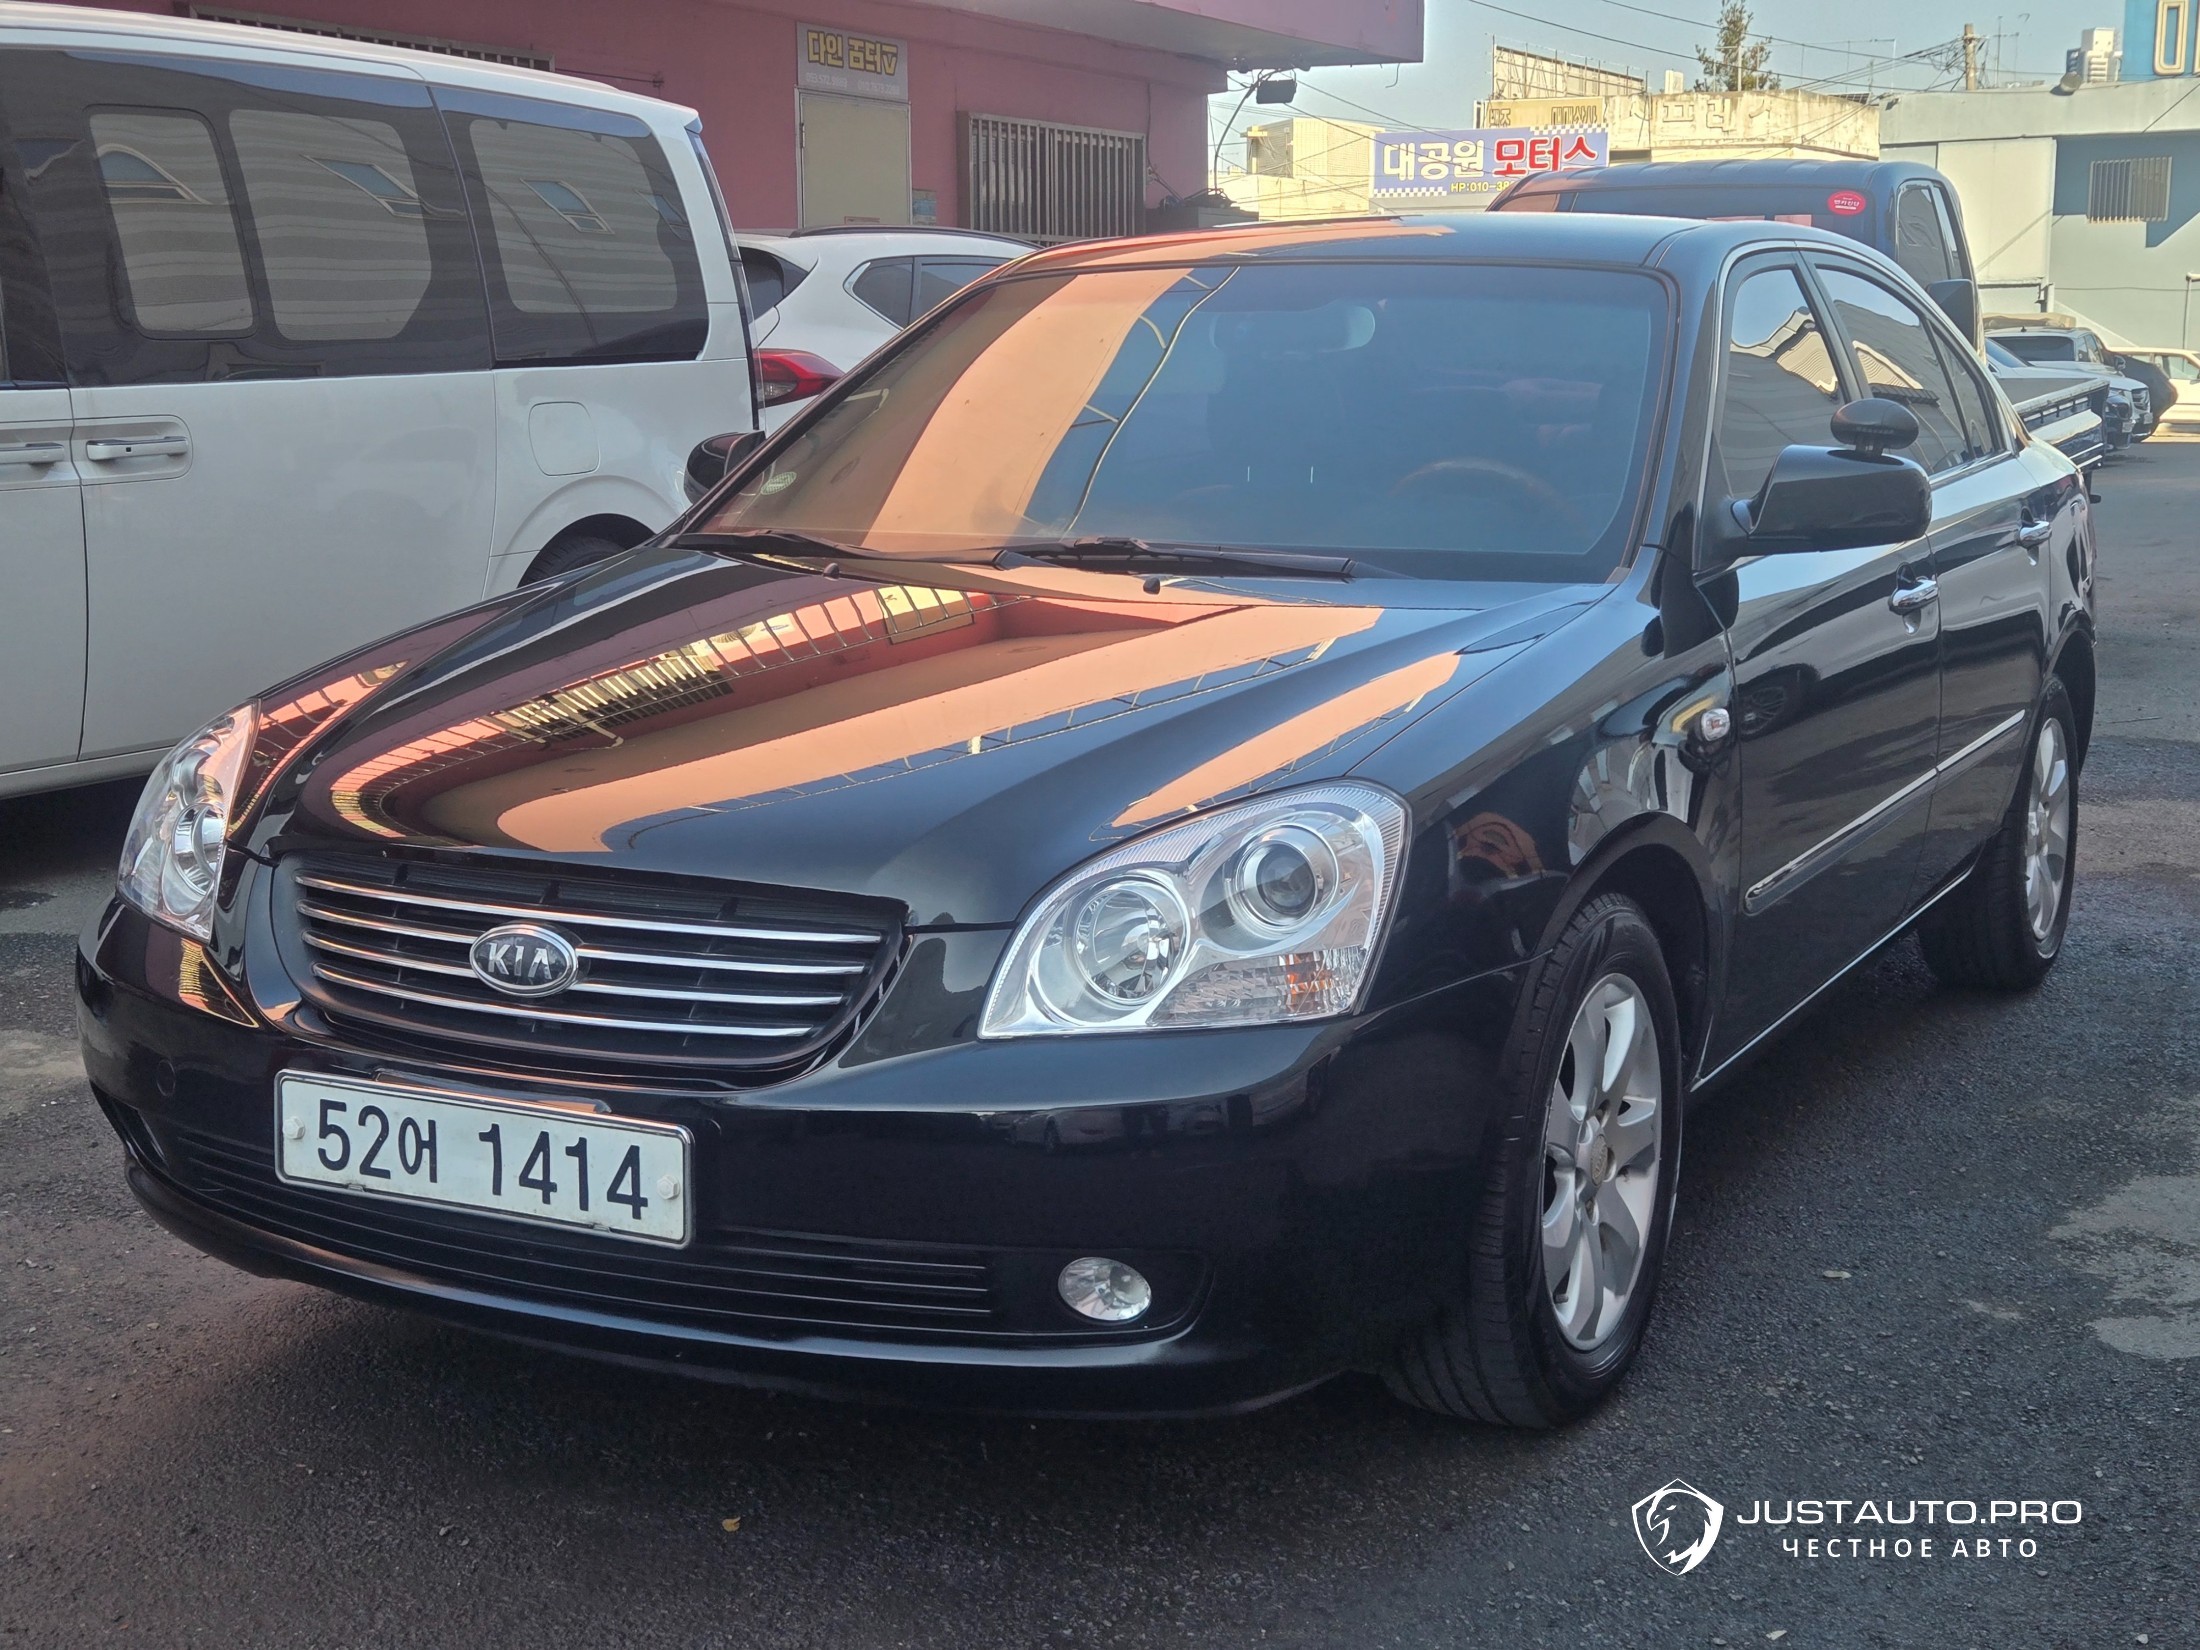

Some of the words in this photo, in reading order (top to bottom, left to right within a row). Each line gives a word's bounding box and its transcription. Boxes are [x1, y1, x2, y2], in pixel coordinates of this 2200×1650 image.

[807, 30, 844, 68] 다인
[1383, 138, 1485, 182] 대공원
[1493, 134, 1598, 177] 모터스
[487, 941, 555, 981] KIA
[317, 1098, 439, 1185] 52어
[478, 1122, 650, 1221] 1414
